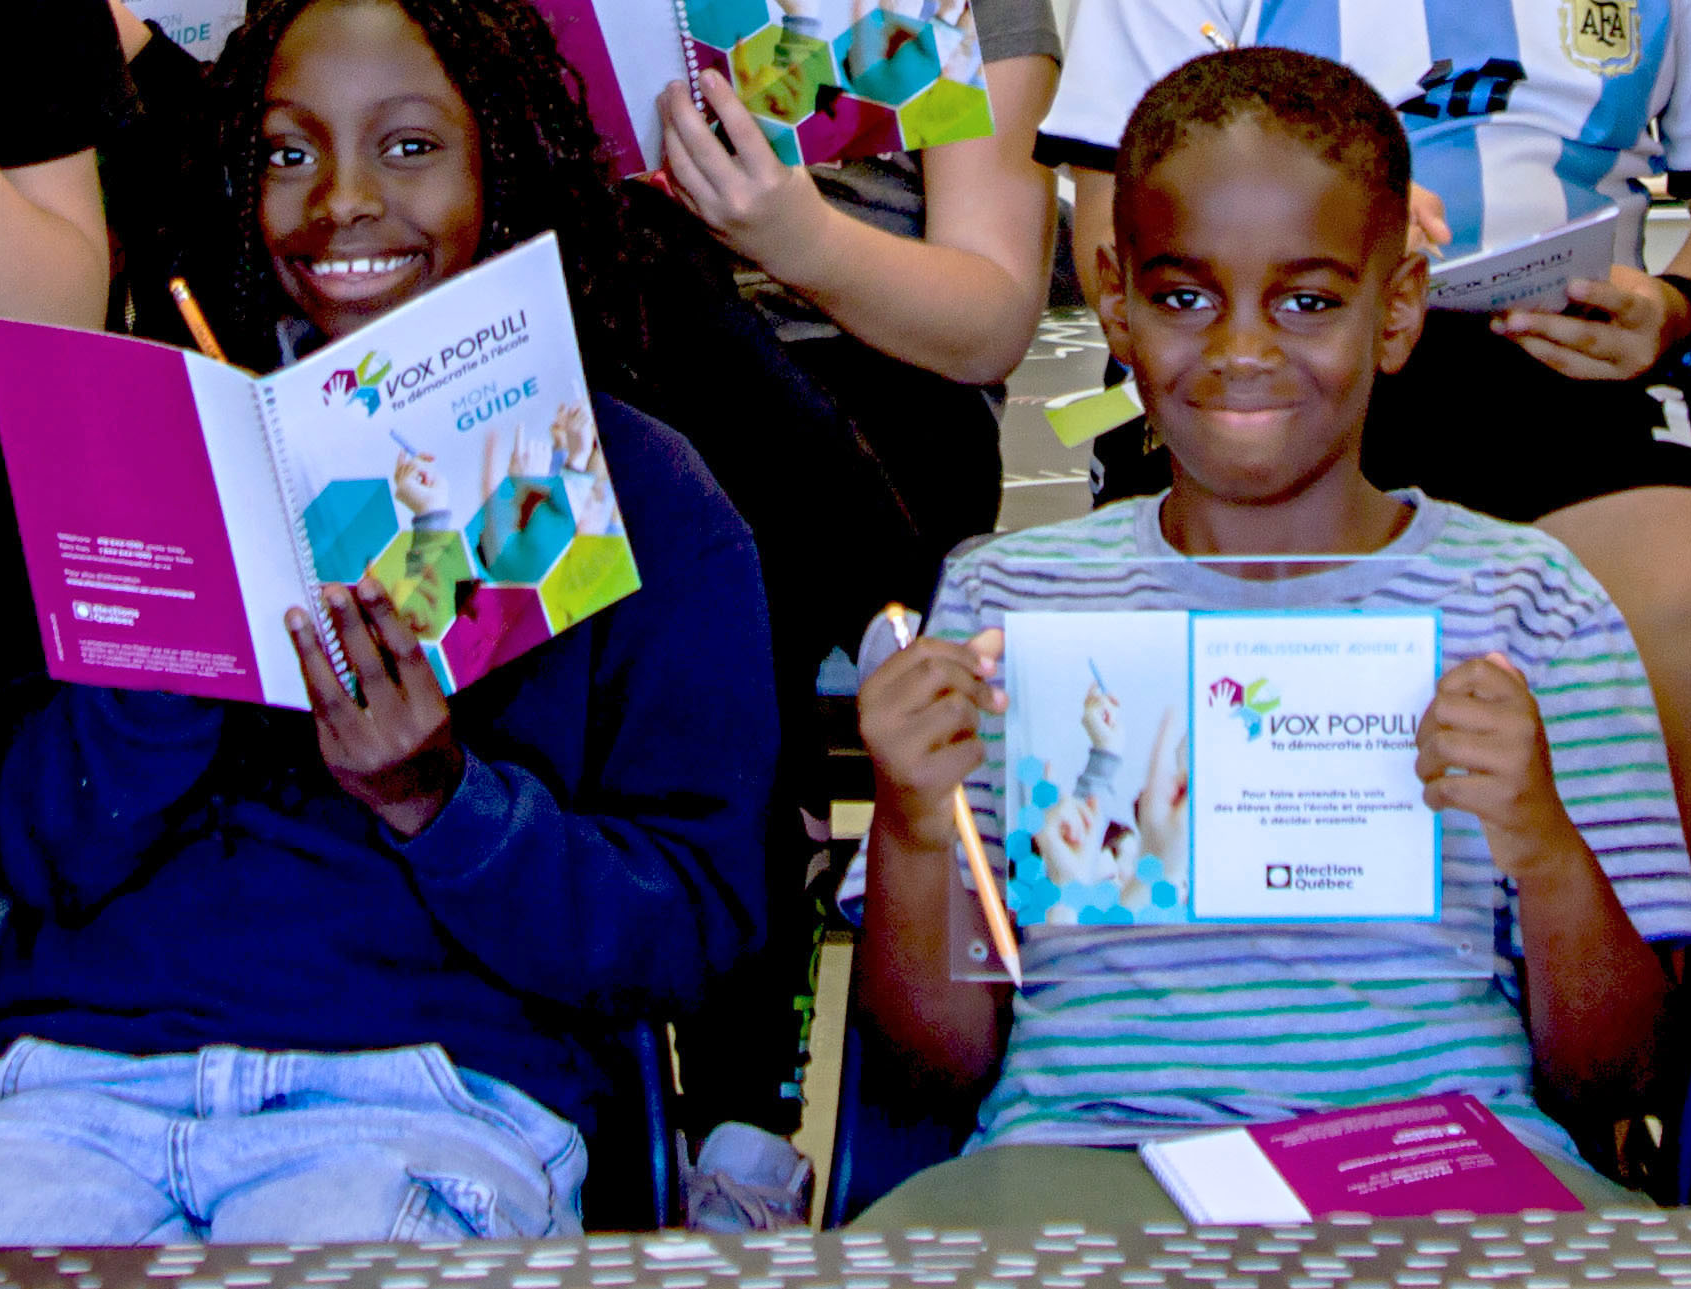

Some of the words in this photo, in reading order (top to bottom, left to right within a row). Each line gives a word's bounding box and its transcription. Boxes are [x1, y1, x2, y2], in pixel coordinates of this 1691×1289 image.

[159, 13, 182, 28] ON
[386, 355, 436, 400] VOX
[440, 309, 528, 371] POPULI
[451, 379, 498, 414] MON
[456, 375, 540, 433] GUIDE
[1271, 714, 1320, 736] VOX
[1329, 714, 1417, 736] POPULI
[1271, 739, 1285, 753] ta
[1288, 738, 1362, 753] démocratie
[1365, 738, 1376, 753] à
[1295, 864, 1365, 878] élections
[1295, 877, 1355, 892] Québec
